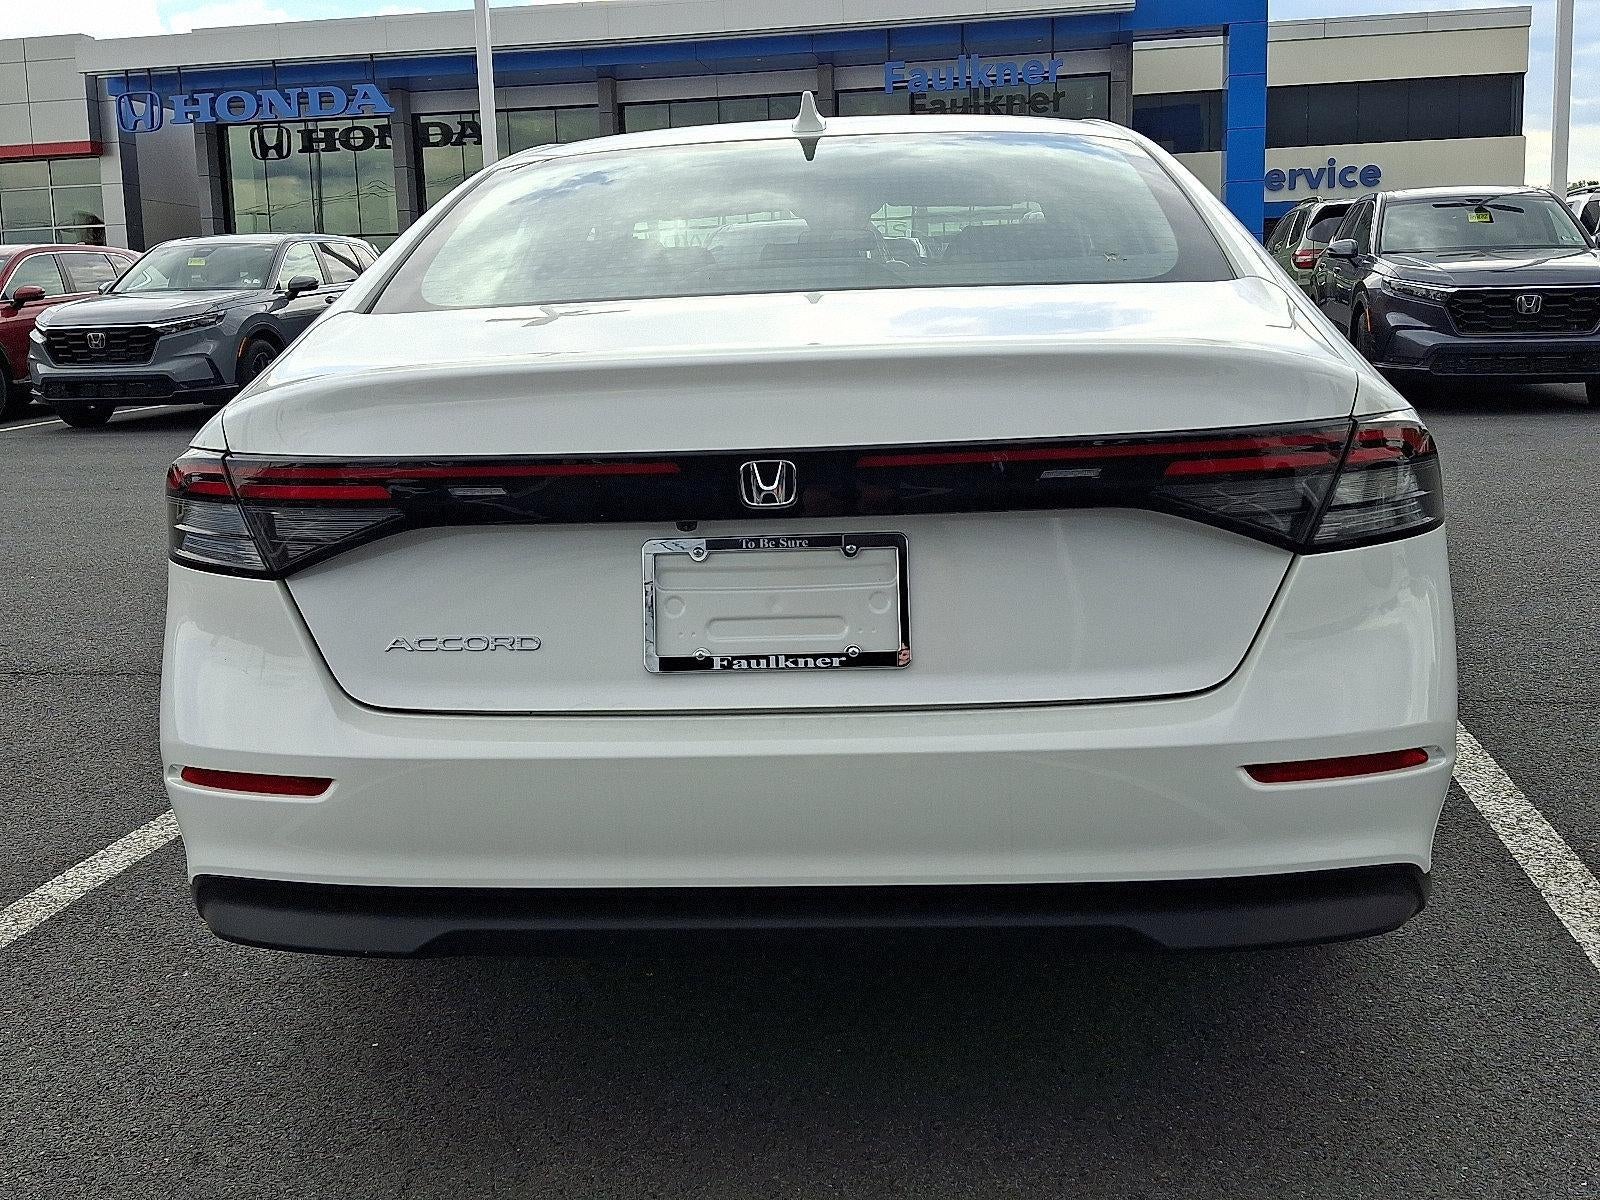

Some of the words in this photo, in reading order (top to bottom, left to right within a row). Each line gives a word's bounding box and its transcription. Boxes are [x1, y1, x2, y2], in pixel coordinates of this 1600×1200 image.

[884, 54, 1064, 95] Faulkner
[169, 83, 395, 125] HONDA
[1264, 157, 1382, 192] ervice
[739, 538, 756, 549] To
[759, 538, 776, 548] Be
[779, 537, 809, 548] Sure
[384, 635, 542, 652] ACCORD
[710, 654, 847, 670] Faulkner
